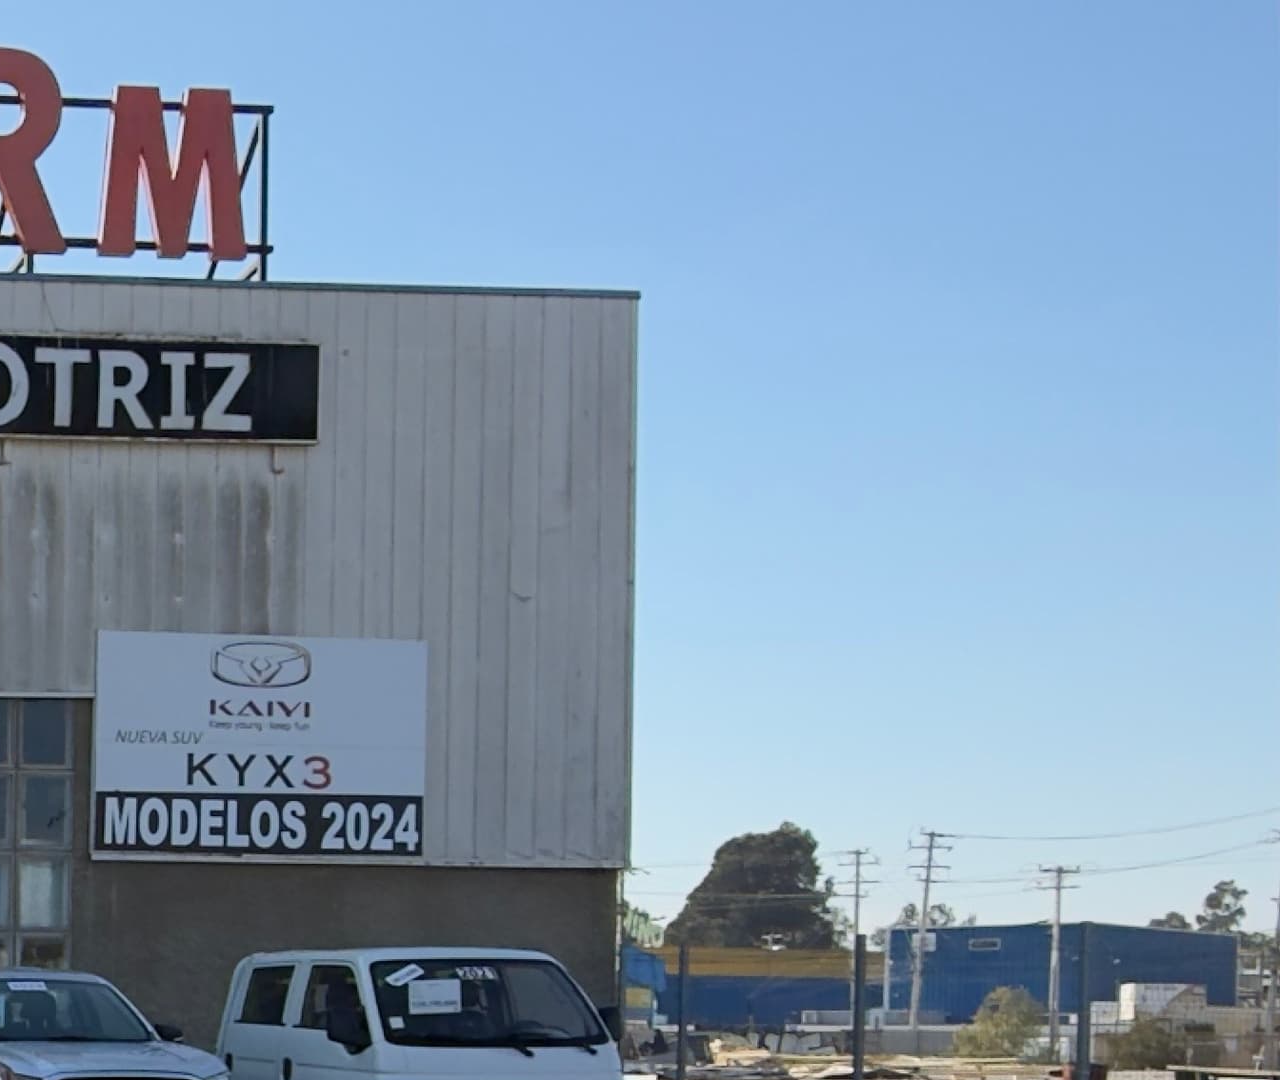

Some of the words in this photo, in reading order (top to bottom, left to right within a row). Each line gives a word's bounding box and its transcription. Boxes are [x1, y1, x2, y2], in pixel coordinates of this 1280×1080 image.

[115, 729, 169, 745] NUEVA
[172, 731, 204, 745] SUV
[186, 752, 332, 790] KYX3
[103, 796, 308, 849] MODELOS
[320, 801, 419, 852] 2024
